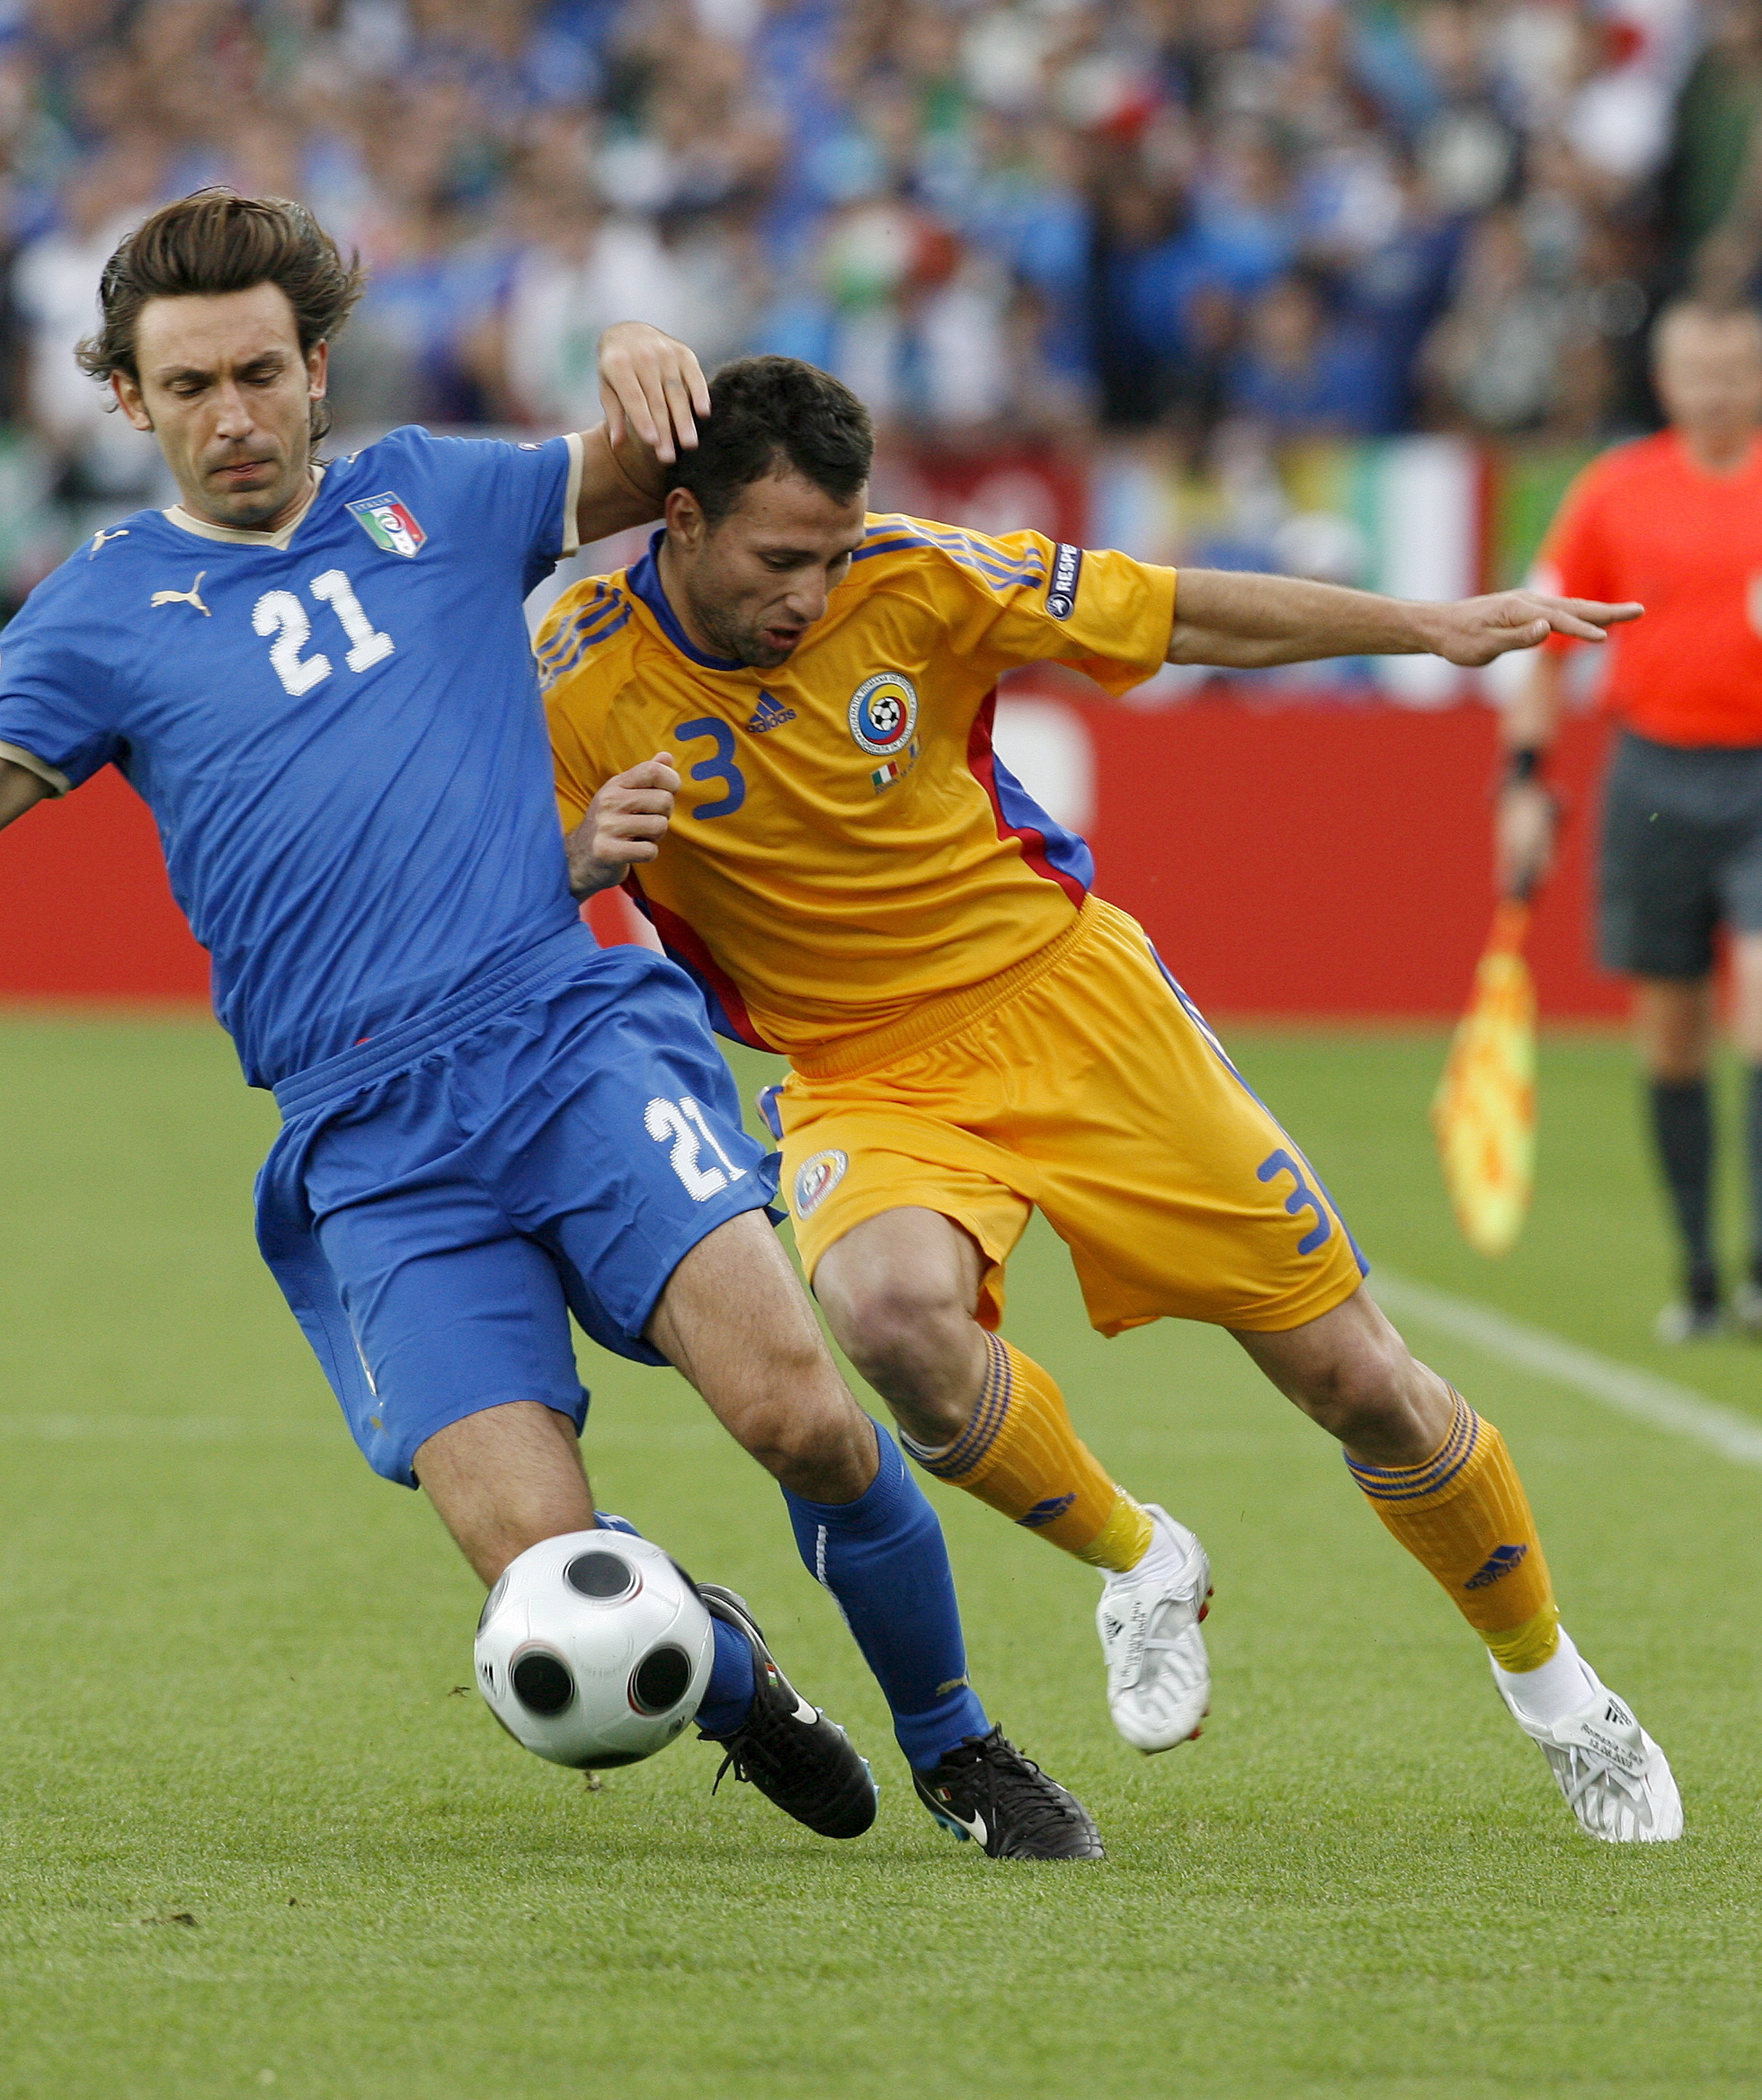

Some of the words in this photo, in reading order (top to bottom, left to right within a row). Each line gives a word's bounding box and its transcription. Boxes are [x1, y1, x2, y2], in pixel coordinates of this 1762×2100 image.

[353, 497, 394, 512] ITALIA
[252, 569, 396, 697] 21
[674, 716, 745, 820] 3
[745, 708, 797, 734] adidas
[644, 1096, 747, 1201] 21
[1256, 1149, 1330, 1254] 3
